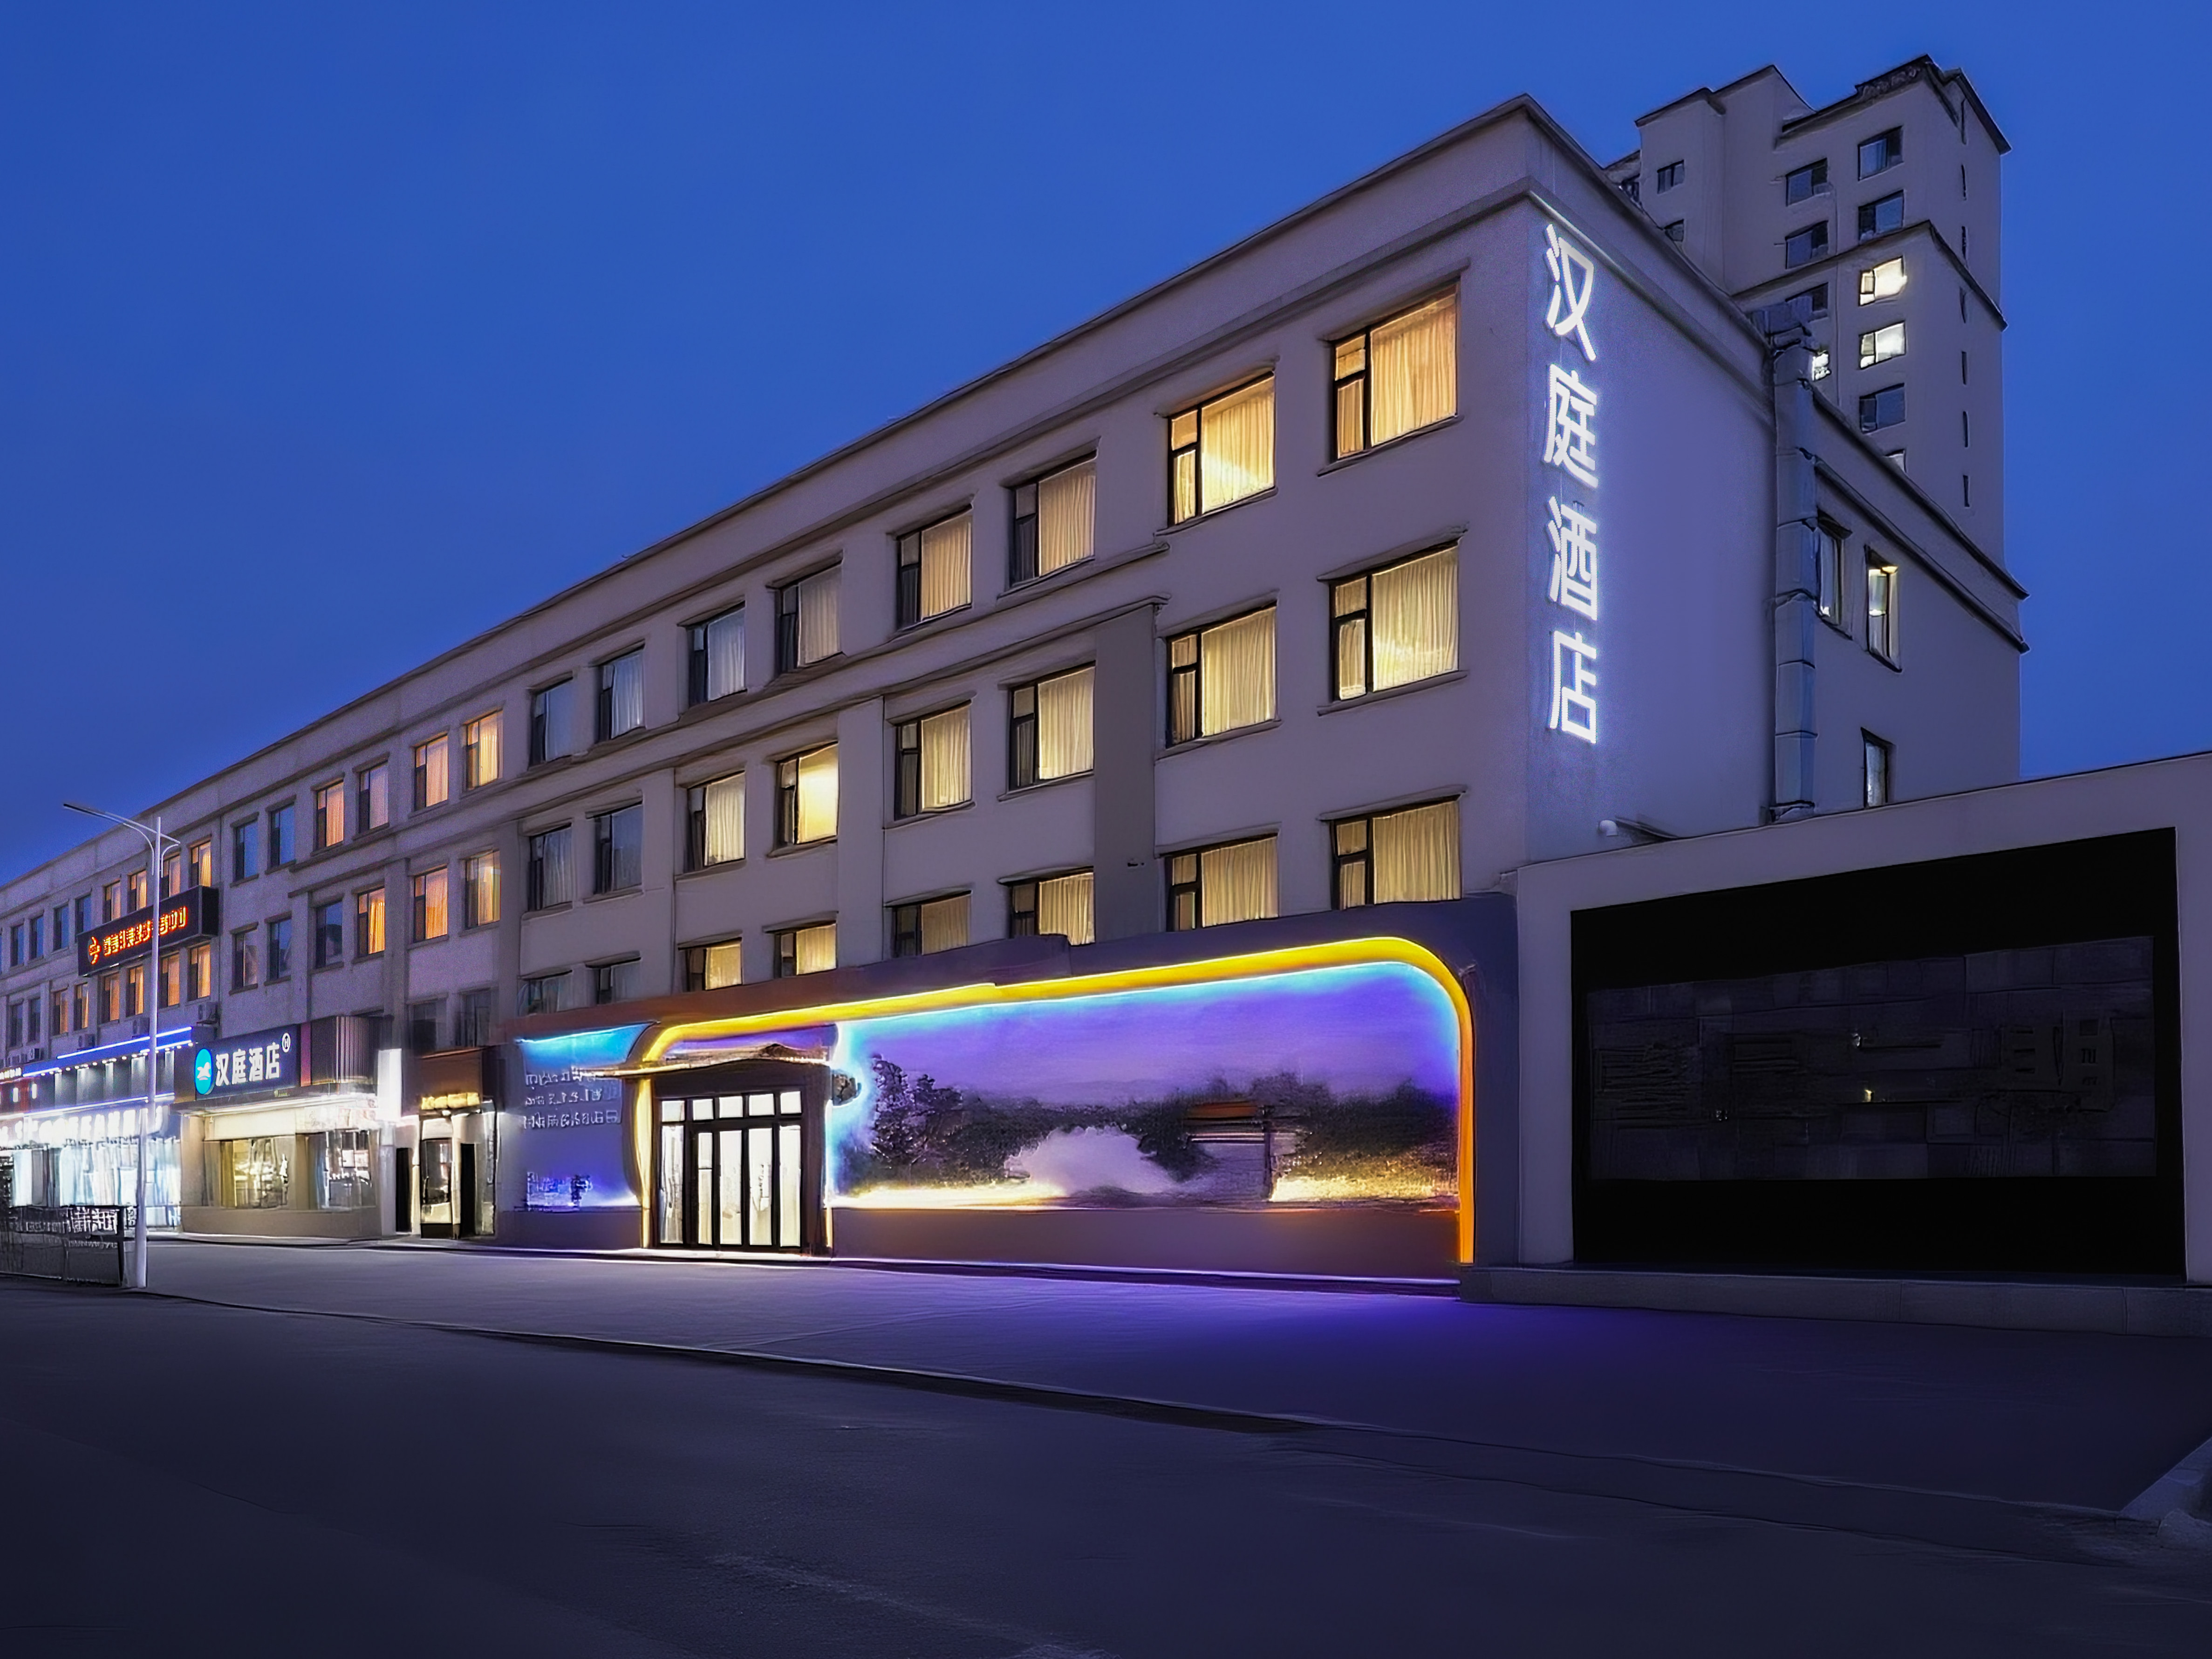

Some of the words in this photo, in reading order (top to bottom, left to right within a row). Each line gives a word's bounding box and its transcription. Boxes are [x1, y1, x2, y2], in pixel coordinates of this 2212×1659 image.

[1544, 224, 1599, 744] 汉庭酒店
[215, 1042, 280, 1086] 汉庭酒店
